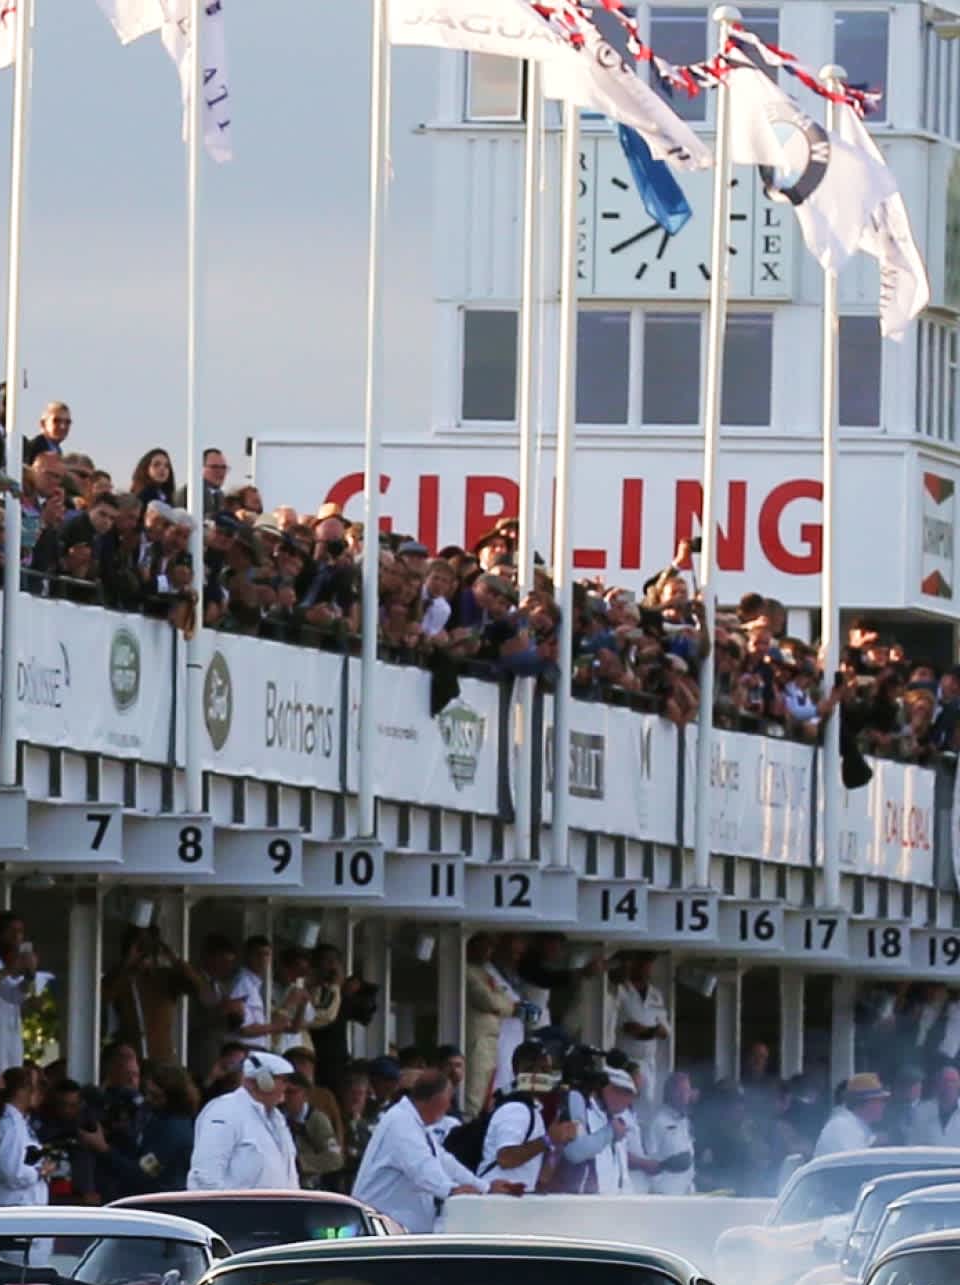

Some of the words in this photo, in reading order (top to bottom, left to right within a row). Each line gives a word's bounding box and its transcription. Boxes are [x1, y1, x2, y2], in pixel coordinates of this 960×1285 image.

[403, 9, 565, 46] JAGUA
[86, 813, 112, 851] 7
[177, 826, 203, 863] 8
[267, 838, 292, 875] 9
[334, 851, 374, 886] 10
[430, 863, 456, 898] 11
[494, 873, 531, 908] 12
[600, 889, 638, 922] 14
[675, 899, 709, 932] 15
[739, 909, 775, 942] 16
[804, 918, 838, 951] 17
[867, 927, 902, 959] 18
[928, 936, 960, 967] 19
